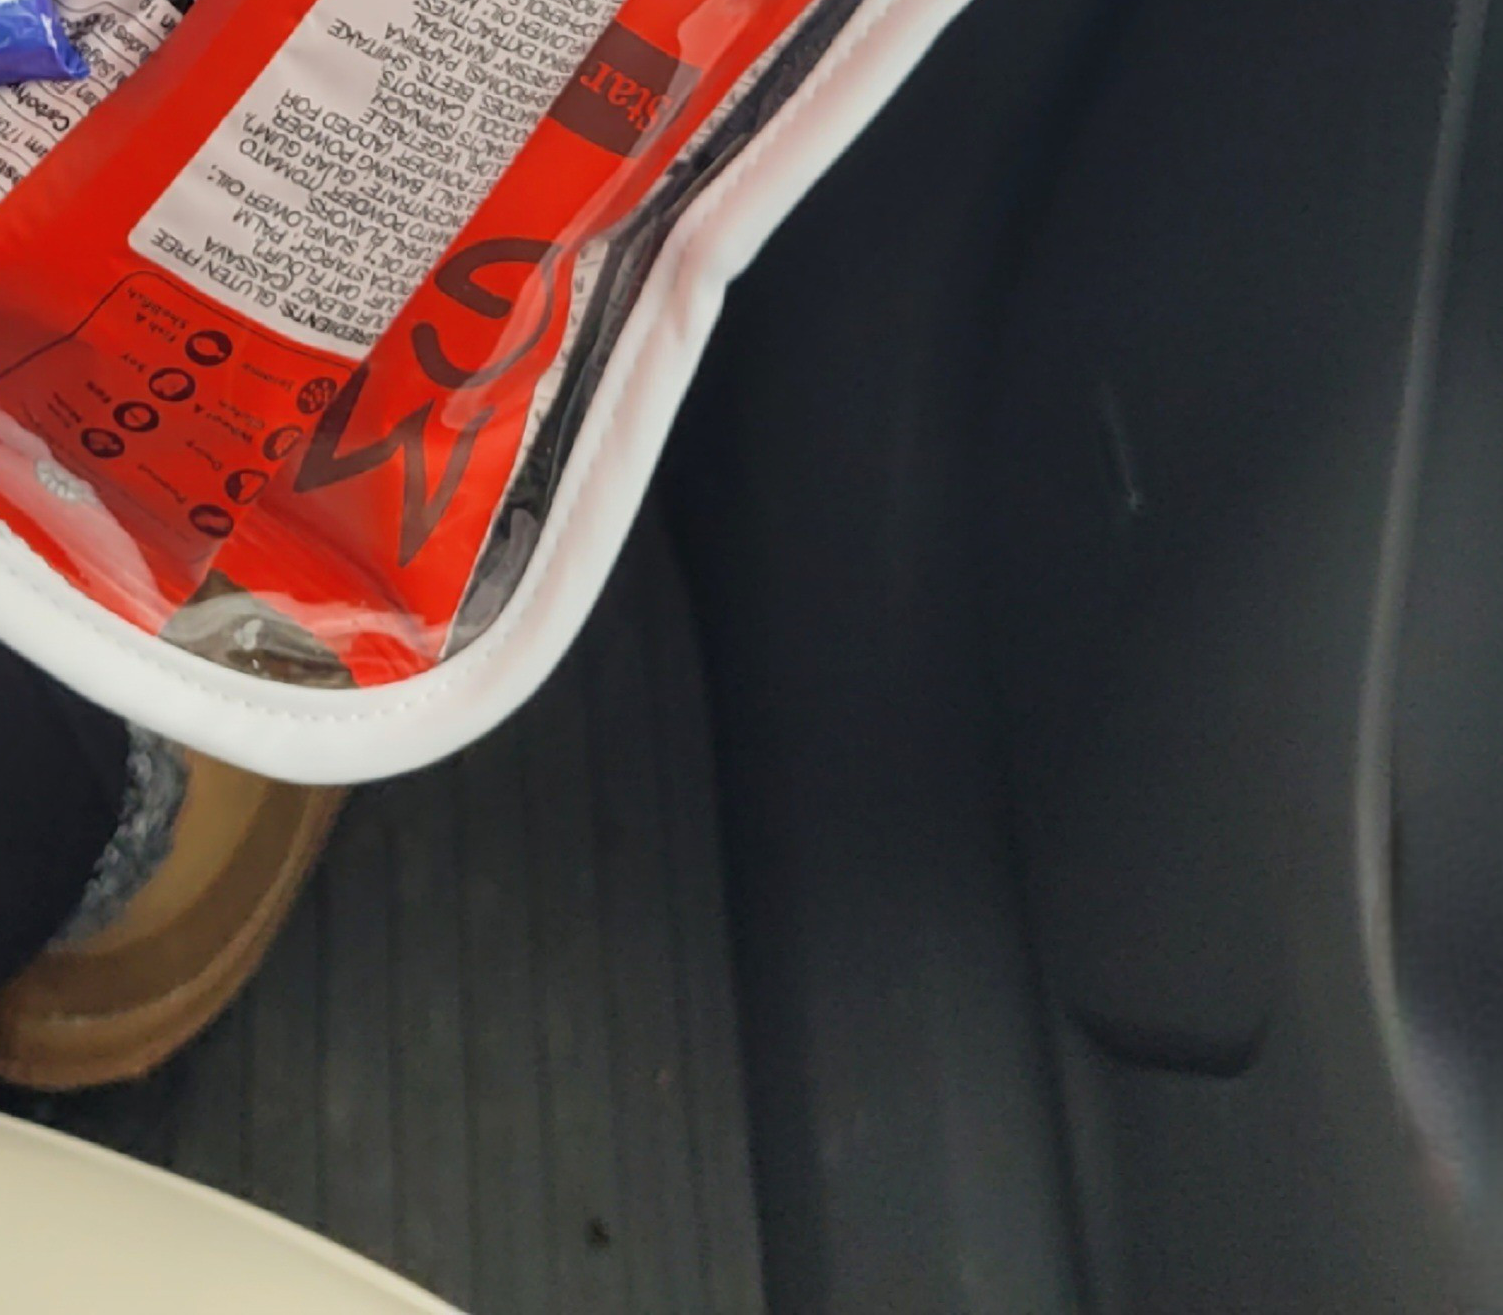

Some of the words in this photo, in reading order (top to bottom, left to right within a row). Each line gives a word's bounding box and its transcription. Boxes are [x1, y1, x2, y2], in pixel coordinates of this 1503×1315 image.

[381, 21, 462, 73] PAPRIKA
[278, 87, 323, 122] FOR
[578, 55, 671, 133] Star
[358, 105, 462, 167] VEGETABLE
[300, 149, 358, 188] GUAR
[355, 152, 426, 196] BAKING
[232, 205, 288, 243] PALM
[243, 186, 360, 257] SUNFLOWER
[148, 226, 204, 269] FREE
[201, 233, 295, 294] (CASSAVA
[201, 258, 279, 309] GLUTEN
[322, 273, 362, 303] OAT
